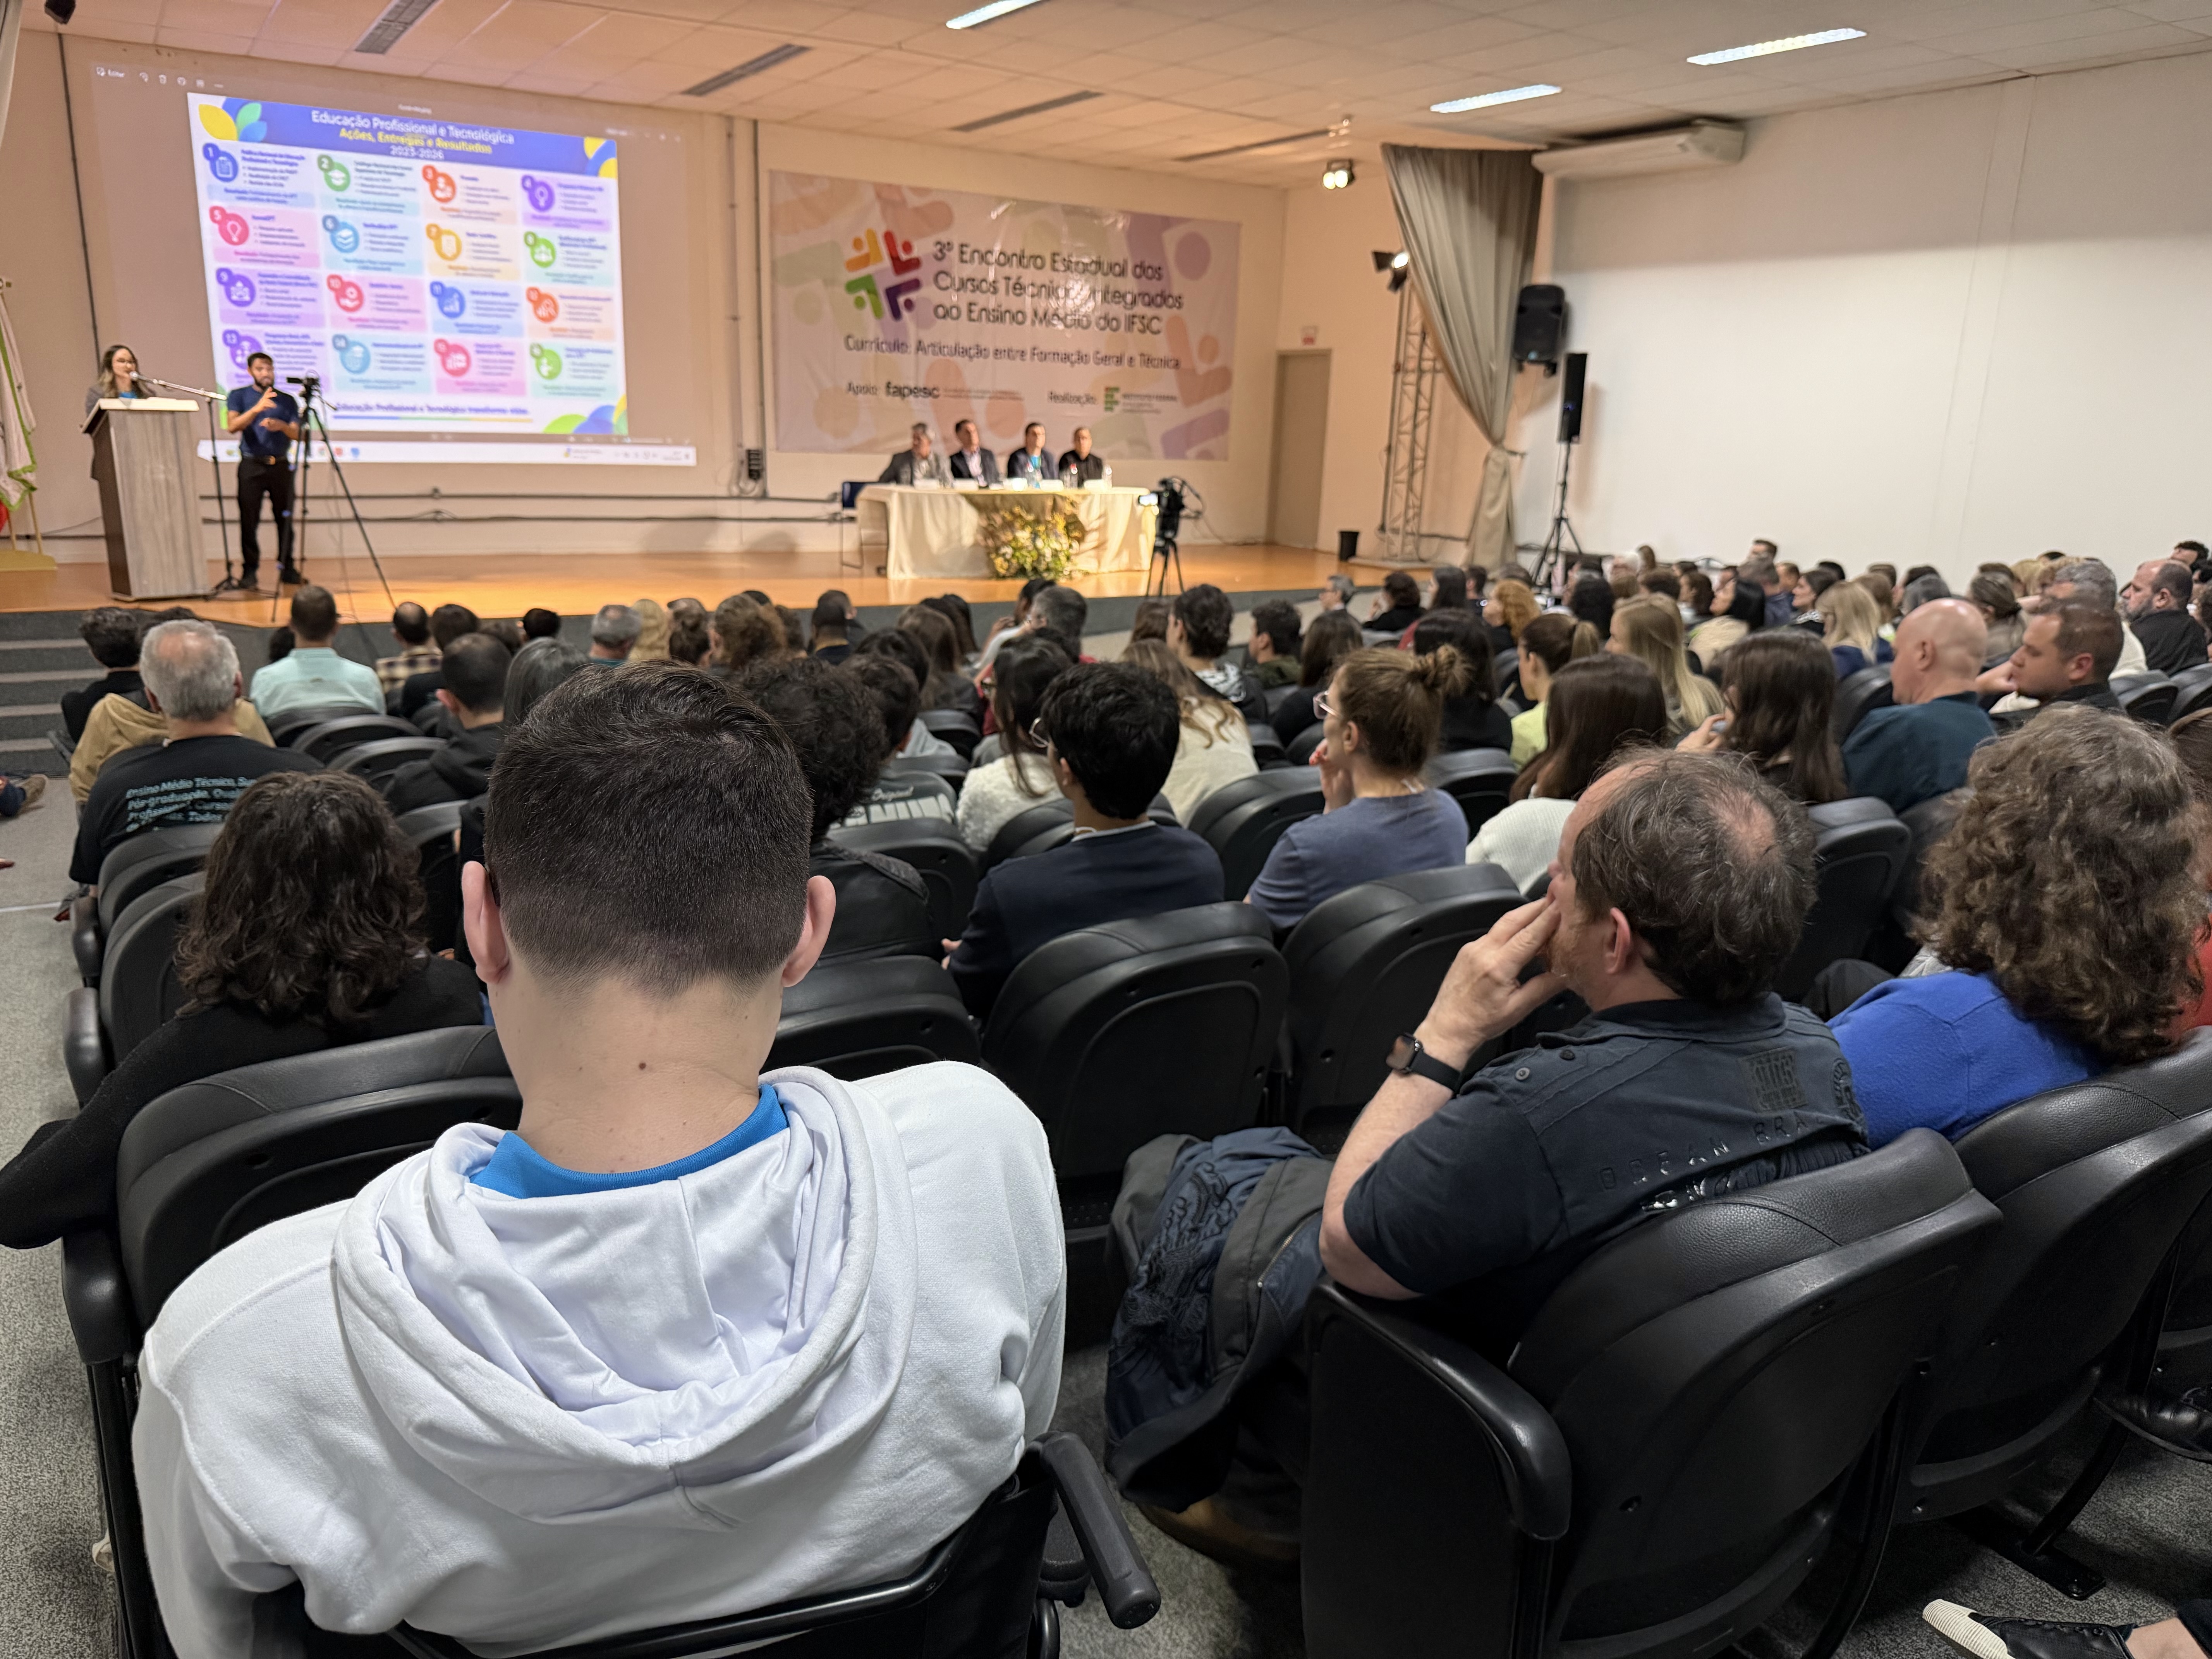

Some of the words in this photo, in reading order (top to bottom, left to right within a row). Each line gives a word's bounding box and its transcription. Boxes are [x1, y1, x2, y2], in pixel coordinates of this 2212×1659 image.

[311, 110, 370, 129] Educação
[372, 117, 437, 136] Profissional
[438, 127, 446, 136] e
[448, 125, 514, 144] Tecnológica
[208, 147, 214, 157] 1
[340, 128, 375, 143] Ações,
[377, 131, 424, 147] Entregas
[427, 139, 433, 147] e
[435, 138, 492, 153] Resultados
[321, 158, 329, 168] 2
[933, 241, 954, 261] 3º
[959, 244, 1045, 270] Encontro
[1050, 251, 1128, 278] Estadual
[1132, 261, 1163, 281] dos
[933, 271, 998, 295] Cursos
[934, 303, 962, 320] ao
[969, 302, 1026, 325] Ensino
[1095, 312, 1121, 332] do
[1124, 314, 1162, 335] IFSC
[917, 340, 990, 362] Articulação
[992, 346, 1027, 362] entre
[1030, 346, 1091, 368] Formação
[1092, 349, 1125, 366] Geral
[1127, 356, 1136, 368] e
[1139, 352, 1182, 369] Técnica
[886, 381, 940, 400] fapesc
[160, 778, 194, 792] Médio
